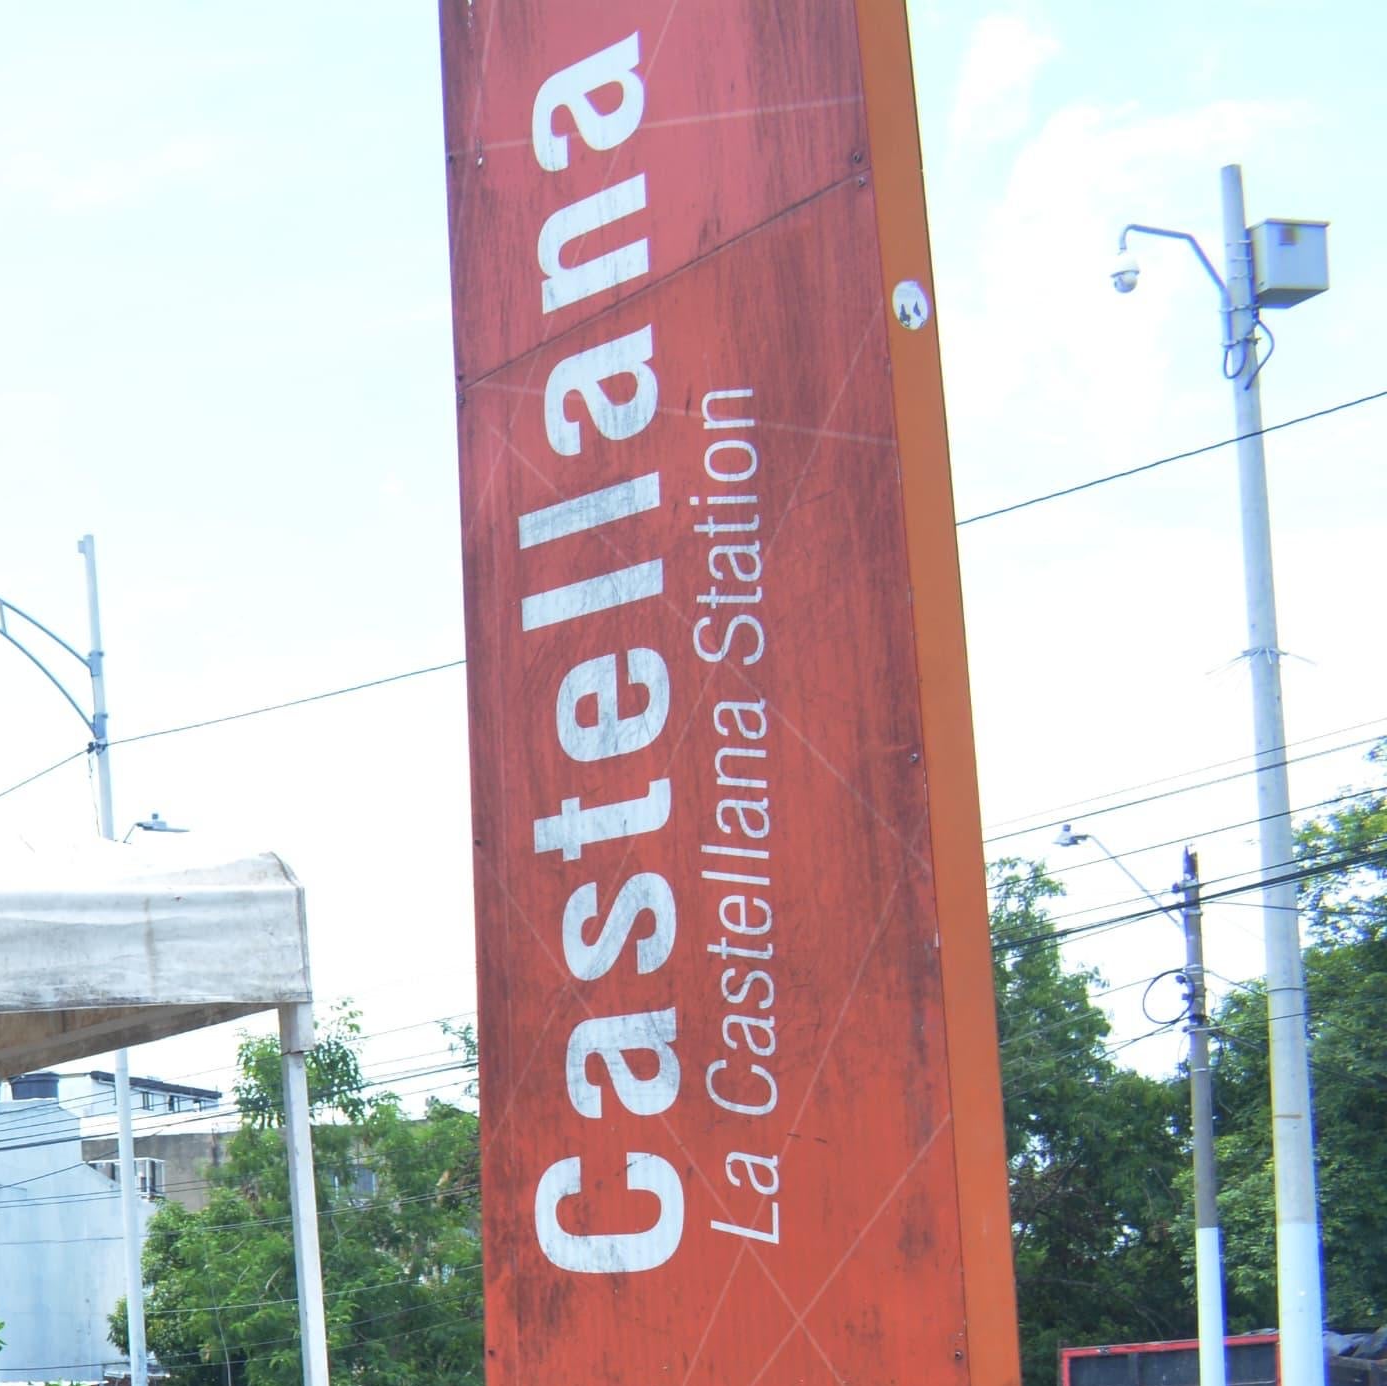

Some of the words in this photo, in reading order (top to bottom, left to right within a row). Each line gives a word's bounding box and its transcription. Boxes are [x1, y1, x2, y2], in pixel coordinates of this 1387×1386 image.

[518, 30, 686, 1274] Castellana
[688, 386, 767, 668] Station
[700, 697, 779, 1118] Castellana
[711, 1153, 780, 1244] La
